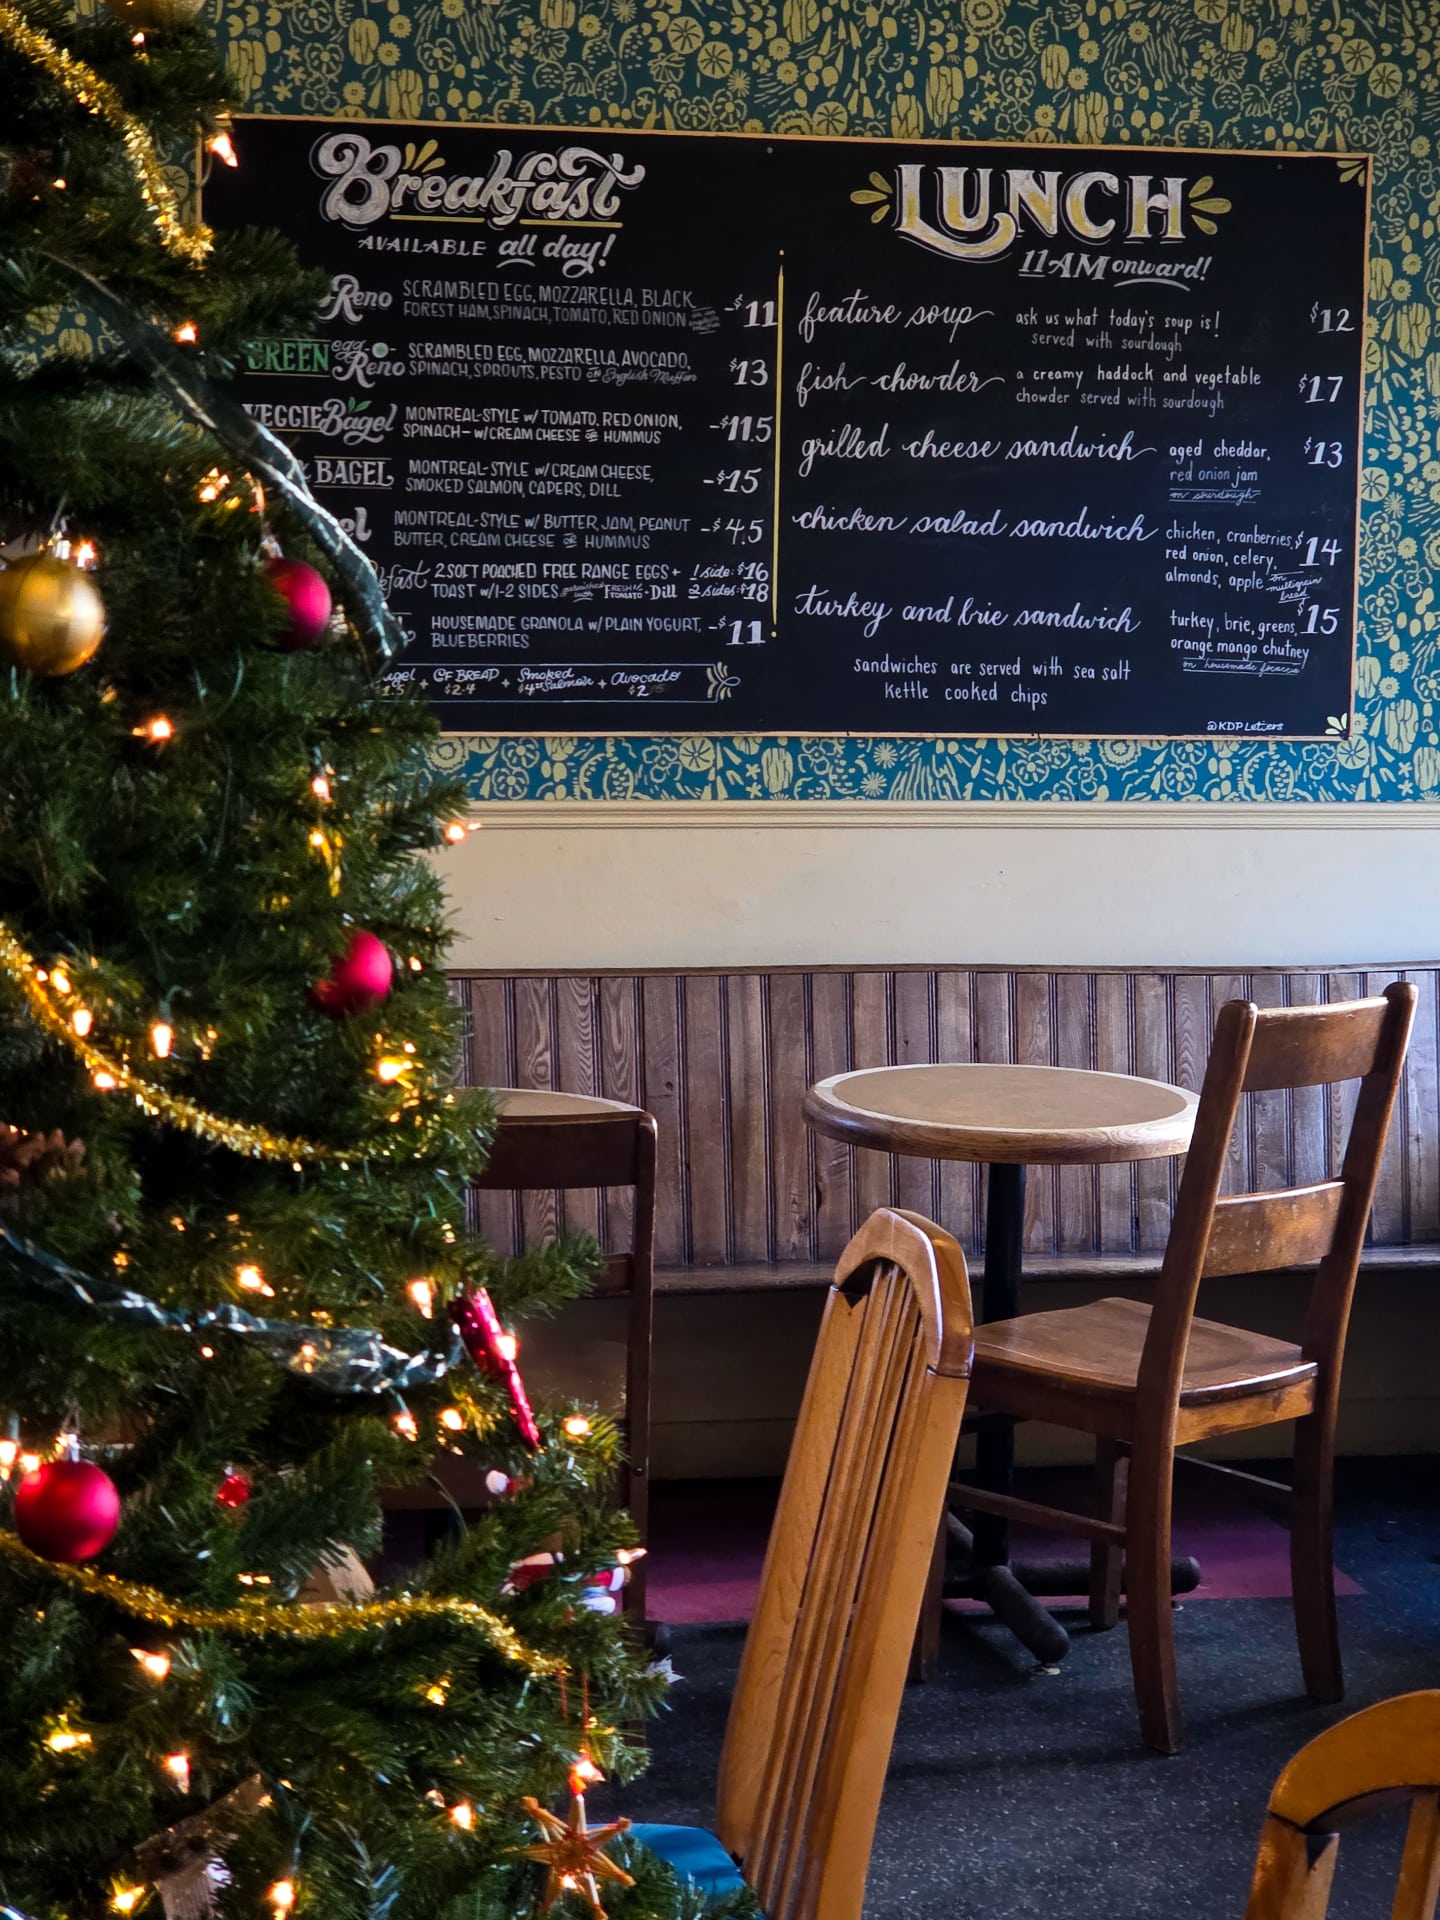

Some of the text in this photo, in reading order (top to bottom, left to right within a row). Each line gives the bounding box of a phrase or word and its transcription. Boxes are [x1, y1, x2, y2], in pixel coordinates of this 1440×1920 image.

[310, 132, 646, 231] Breakfast
[892, 163, 1188, 263] LUNCH
[358, 233, 616, 279] AVAILABLE all day!
[1018, 249, 1213, 283] 11AM onward!
[402, 279, 697, 309] SCRAMBLED EGG, MOZZARELLA, BLACK
[403, 301, 455, 318] FOREST
[612, 308, 639, 326] RED
[641, 311, 687, 328] ONION
[798, 289, 995, 344] feature soup
[1016, 306, 1221, 338] ask us what today's soup is!
[1310, 301, 1355, 334] $12
[408, 342, 493, 361] SCRAMBLED
[528, 347, 620, 367] MOZZARELLA,
[621, 350, 692, 371] AVOCADO,
[1031, 328, 1183, 362] served with sourdough
[331, 350, 406, 389] Reno
[541, 365, 582, 381] PESTO
[729, 357, 768, 386] $13
[796, 359, 1006, 407] fish chowder
[1016, 363, 1262, 390] a creamy haddock and vegetable
[1015, 387, 1225, 418] chowder served with sourdough
[1299, 373, 1344, 404] $17
[242, 398, 398, 446] VEGGIE Bagel
[405, 406, 521, 424] MONTREAL-STYLE
[540, 410, 600, 426] TOMATO,
[602, 412, 632, 427] RED
[633, 414, 683, 431] ONION,
[535, 428, 581, 442] CHEESE
[603, 430, 662, 444] HUMMUS
[798, 422, 1158, 478] grilled cheese sandwich
[1169, 438, 1272, 465] aged cheddar,
[1304, 436, 1343, 468] $13
[314, 460, 394, 486] BAGEL
[408, 459, 529, 478] MONTREAL-STYLE
[551, 463, 598, 478] CREAM
[600, 465, 655, 484] CHEESE,
[1170, 460, 1258, 488] red onion jam
[405, 478, 622, 499] SMOKED SALMON, CAPERS, DILL
[394, 510, 521, 528] MONTREAL-STYLE
[543, 514, 600, 531] BUTTER,
[601, 516, 637, 532] JAM,
[639, 517, 692, 531] PEANUT
[792, 505, 1159, 541] chicken salad sandwich
[1166, 519, 1294, 550] chicken, cranberries,
[394, 530, 650, 549] BUTTER, CREAM CHEESE HUMMUS
[1295, 531, 1342, 567] $14
[482, 562, 537, 579] POACHED
[543, 563, 577, 578] FREE
[582, 563, 631, 580] RANGE
[635, 564, 670, 580] EGGS
[737, 562, 769, 582] $16
[1165, 545, 1278, 575] red onion, celery,
[430, 583, 477, 598] TOAST
[518, 583, 559, 599] SIDES
[650, 584, 678, 600] Dill
[739, 583, 769, 602] $18
[1165, 566, 1264, 592] almonds, apple
[431, 615, 516, 631] HOUSEMADE
[521, 615, 583, 631] GRANOLA
[604, 617, 644, 632] PLAIN
[646, 617, 702, 634] YOGURT,
[794, 585, 1142, 638] turkey and brie sandwich
[1170, 609, 1298, 640] turkey, brie, greens,
[1297, 597, 1341, 635] $15
[429, 632, 530, 649] BLUEBERRIES
[1170, 638, 1310, 670] orange mango chutney
[455, 668, 500, 683] BREAD
[853, 653, 1133, 681] sandwiches are served with sea salt
[944, 681, 998, 701] cooked
[1011, 684, 1049, 711] chips
